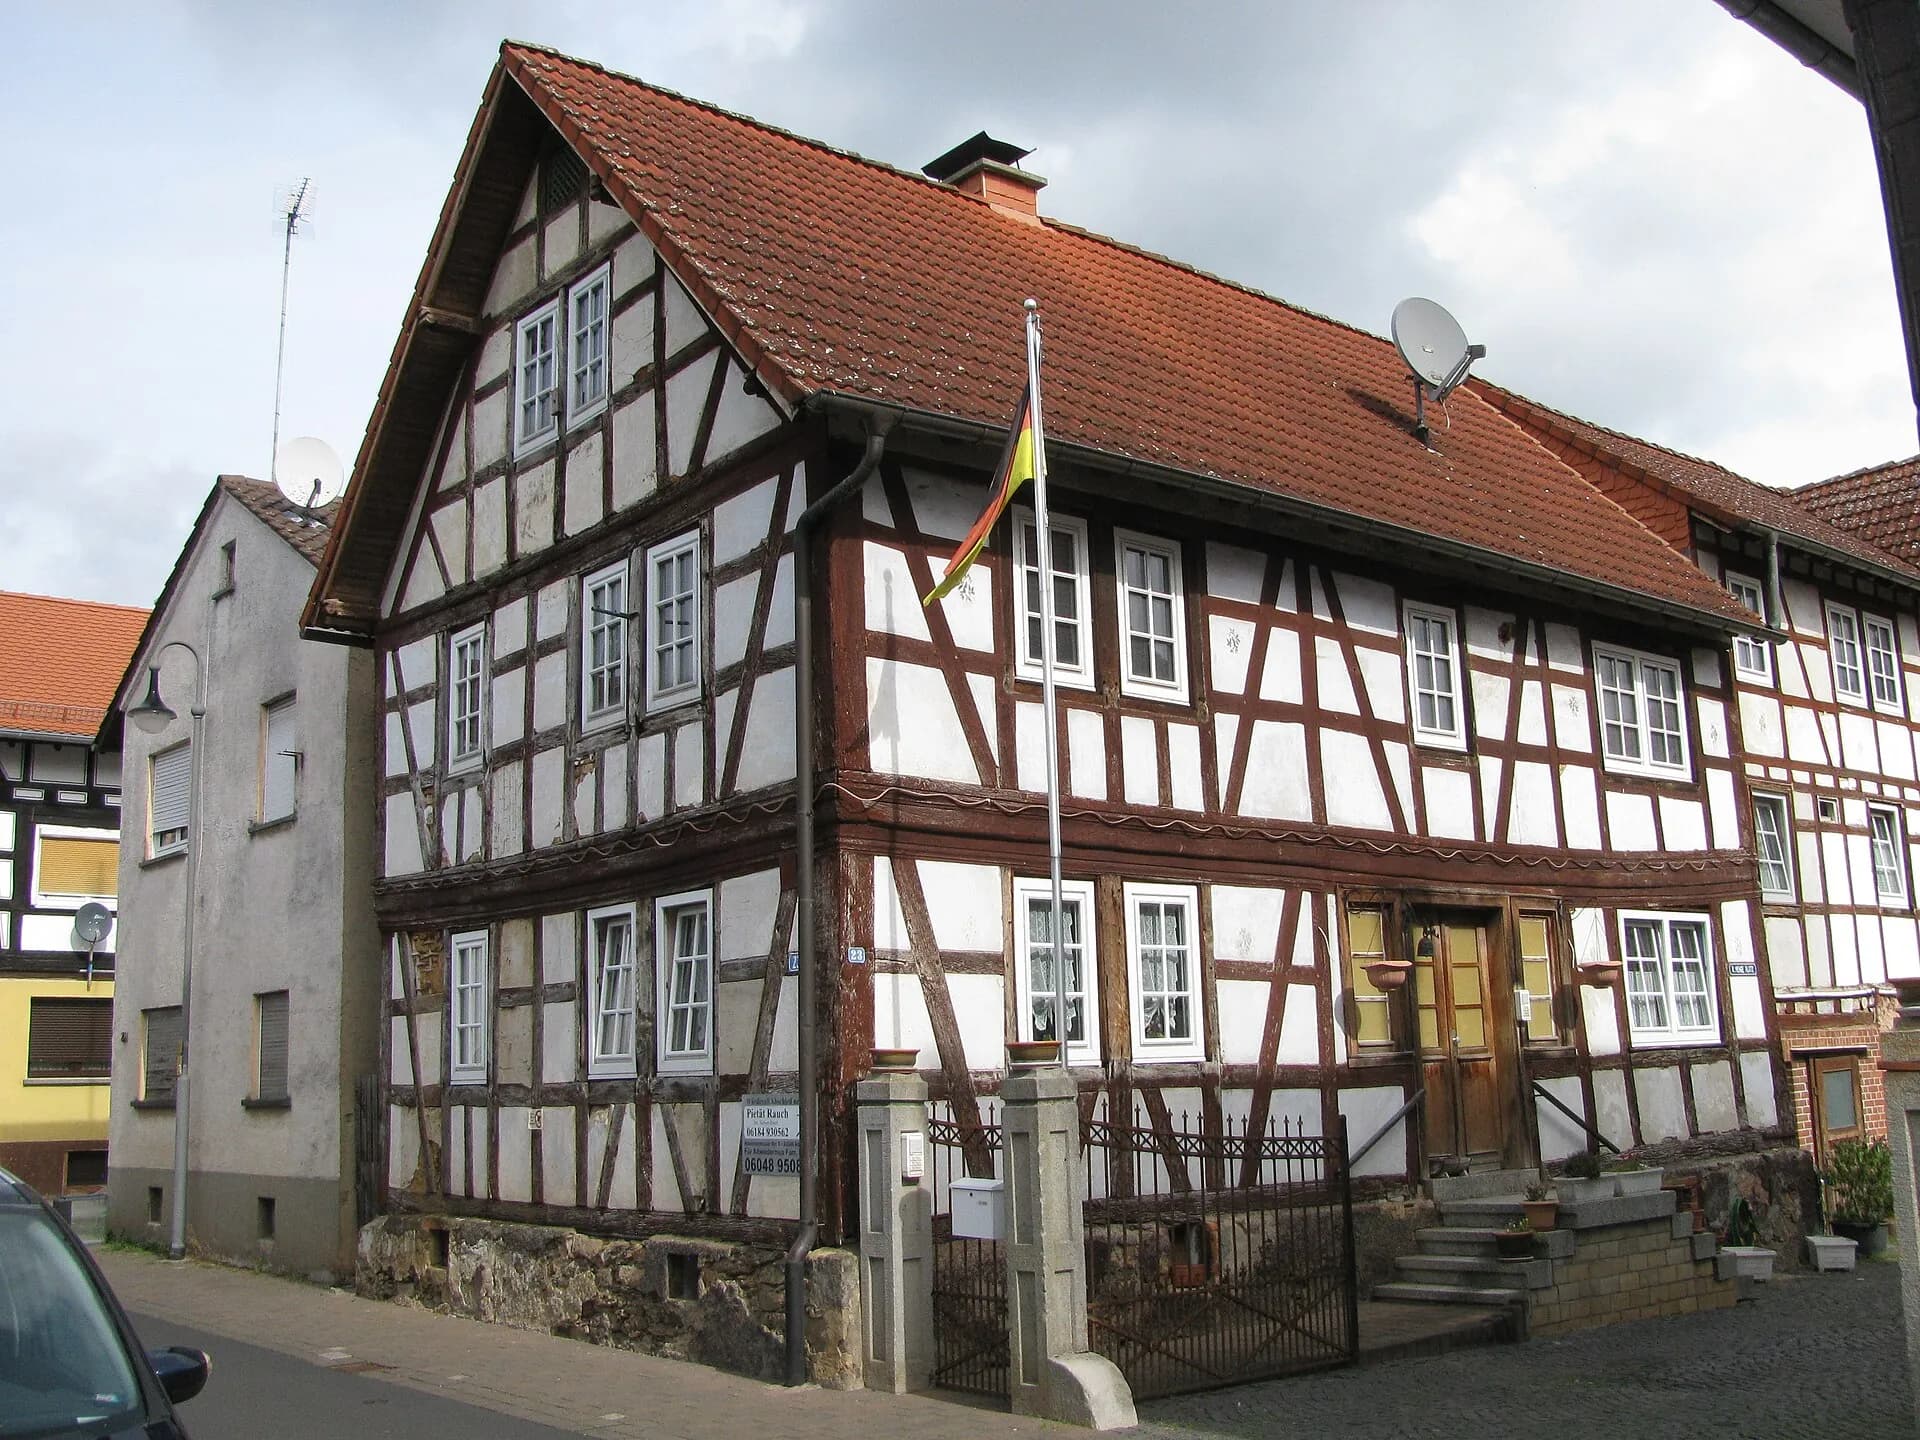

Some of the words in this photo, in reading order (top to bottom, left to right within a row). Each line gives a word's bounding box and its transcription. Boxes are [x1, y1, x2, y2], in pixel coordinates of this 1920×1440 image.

[850, 949, 863, 961] 23
[746, 1108, 765, 1119] Pietät
[767, 1107, 789, 1119] Rauch
[746, 1127, 765, 1138] 06184
[766, 1127, 789, 1137] 930562
[745, 1157, 774, 1172] 06048
